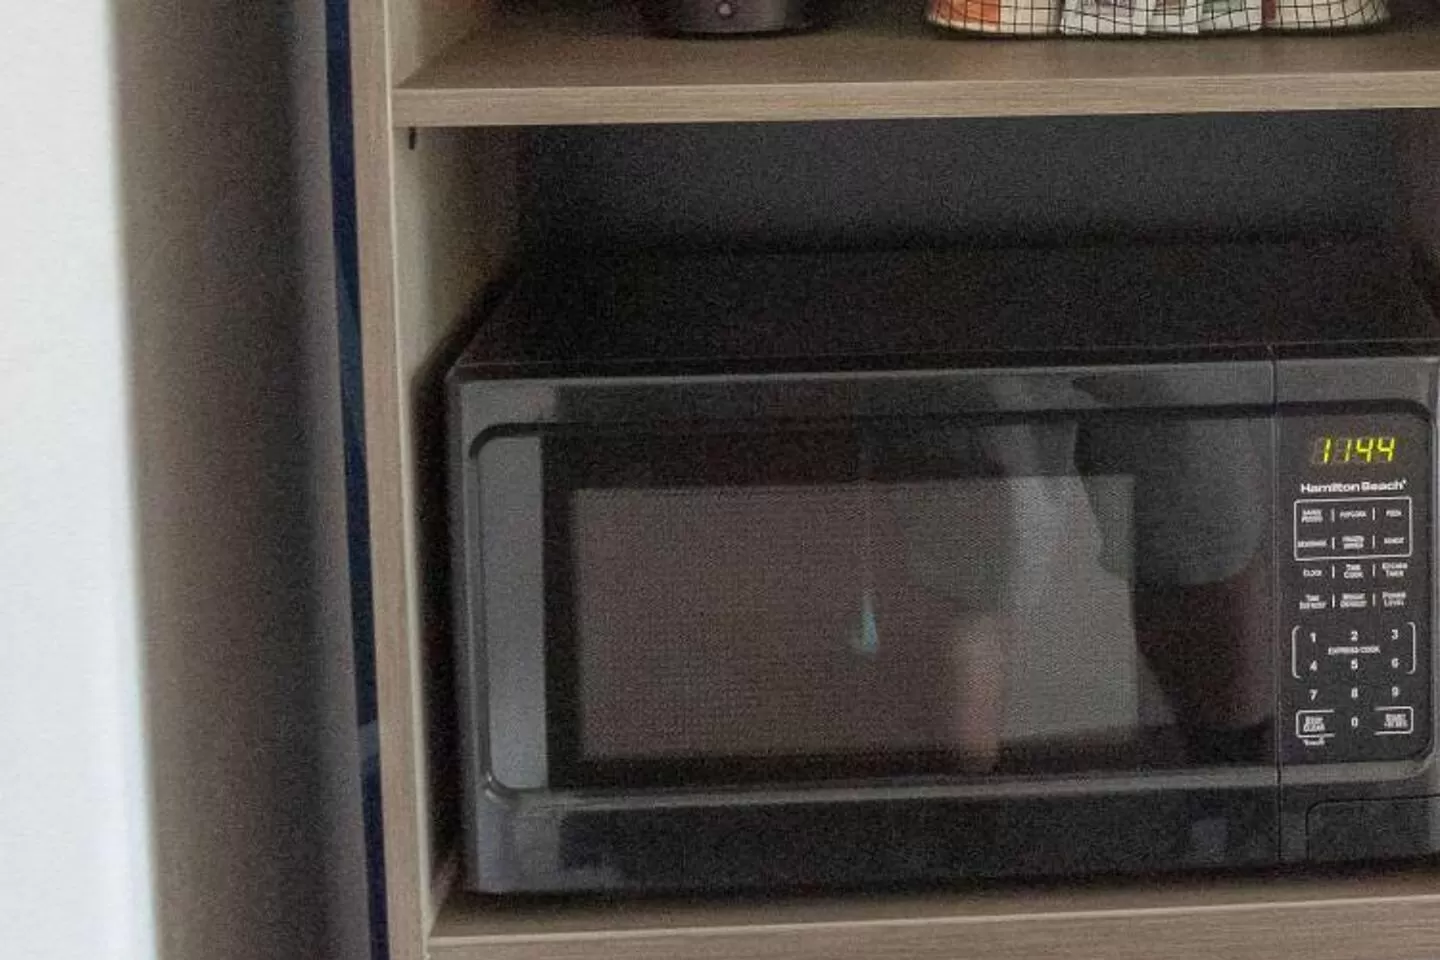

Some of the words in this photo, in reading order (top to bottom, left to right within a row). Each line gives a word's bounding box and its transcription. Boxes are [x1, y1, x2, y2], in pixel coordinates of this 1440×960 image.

[1300, 483, 1360, 493] Hamilton
[1310, 632, 1316, 643] 1
[1351, 630, 1358, 641] 2
[1391, 629, 1398, 640] 3
[1309, 660, 1318, 672] 4
[1351, 659, 1358, 670] 5
[1391, 658, 1398, 669] 6
[1309, 689, 1318, 700] 7
[1351, 687, 1358, 698] 8
[1391, 686, 1399, 697] 9
[1351, 717, 1358, 728] 0
